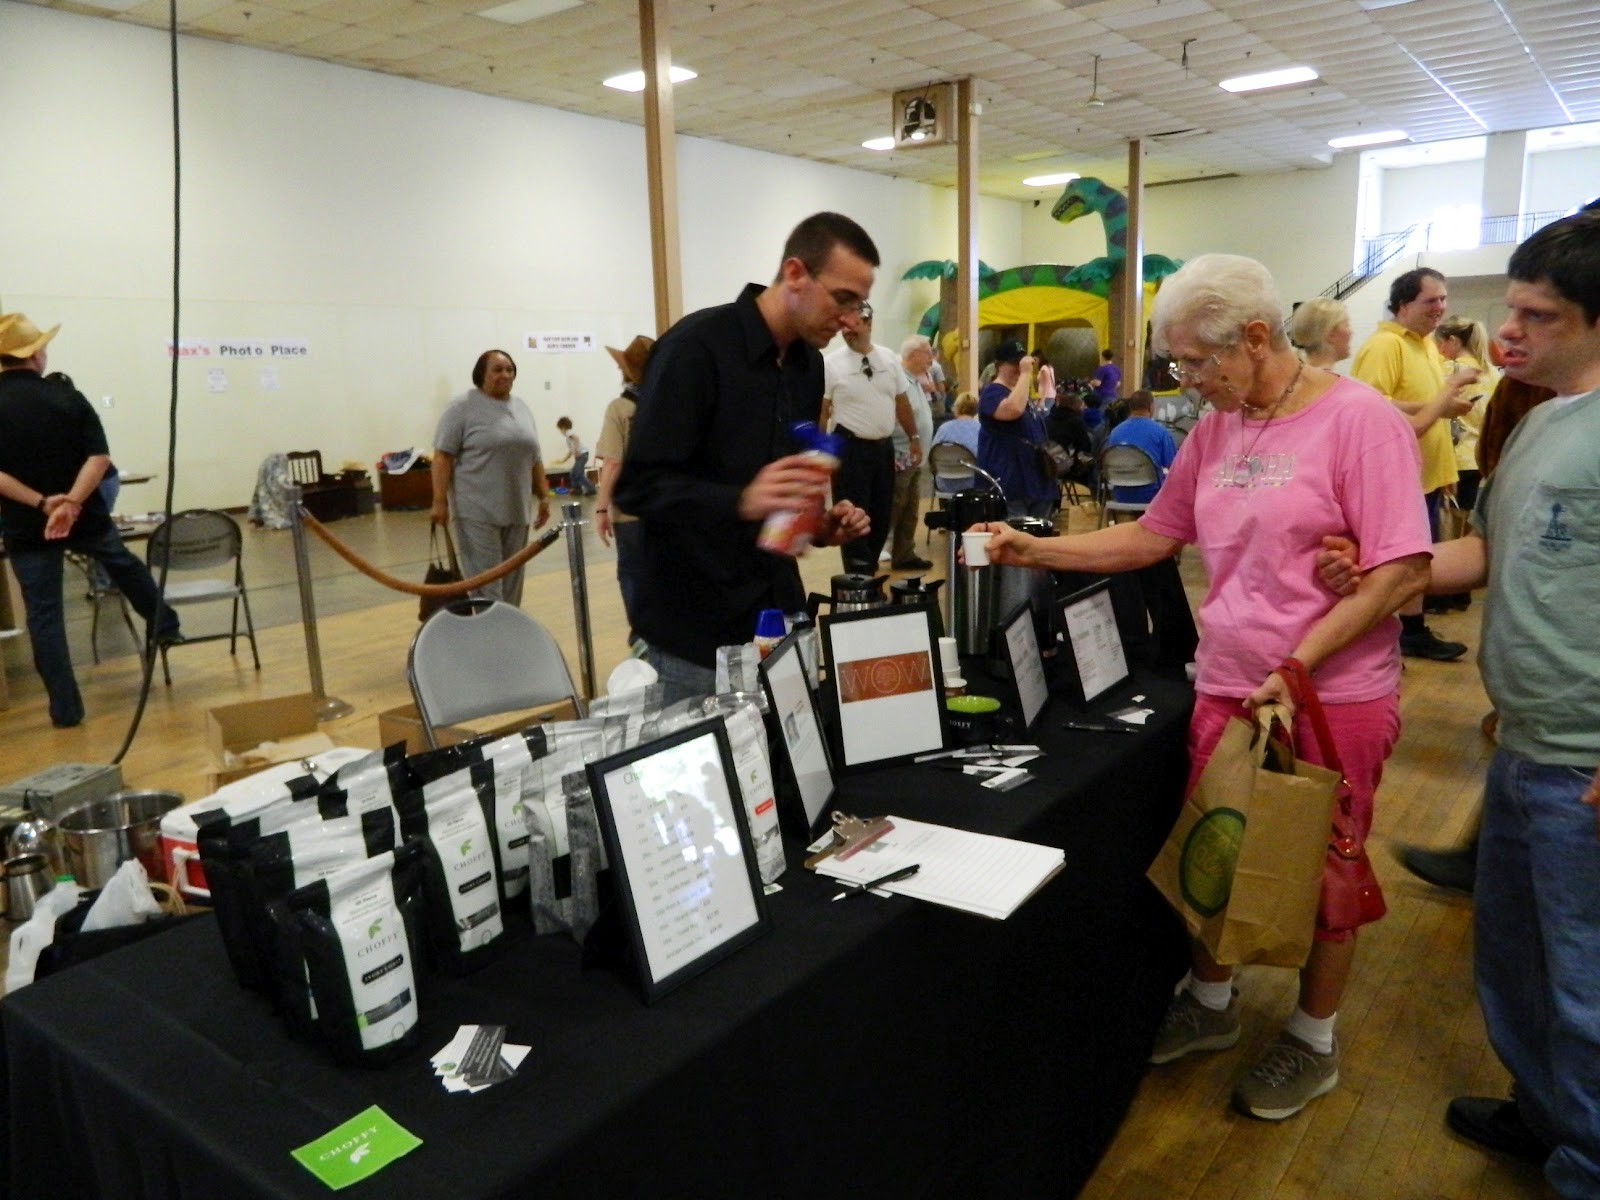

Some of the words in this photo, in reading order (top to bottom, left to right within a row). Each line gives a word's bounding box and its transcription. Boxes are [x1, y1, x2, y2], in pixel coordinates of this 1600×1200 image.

[270, 345, 308, 356] Place
[841, 658, 927, 694] WOW
[357, 930, 400, 957] CHOFFY
[319, 1125, 377, 1160] CHOFFY
